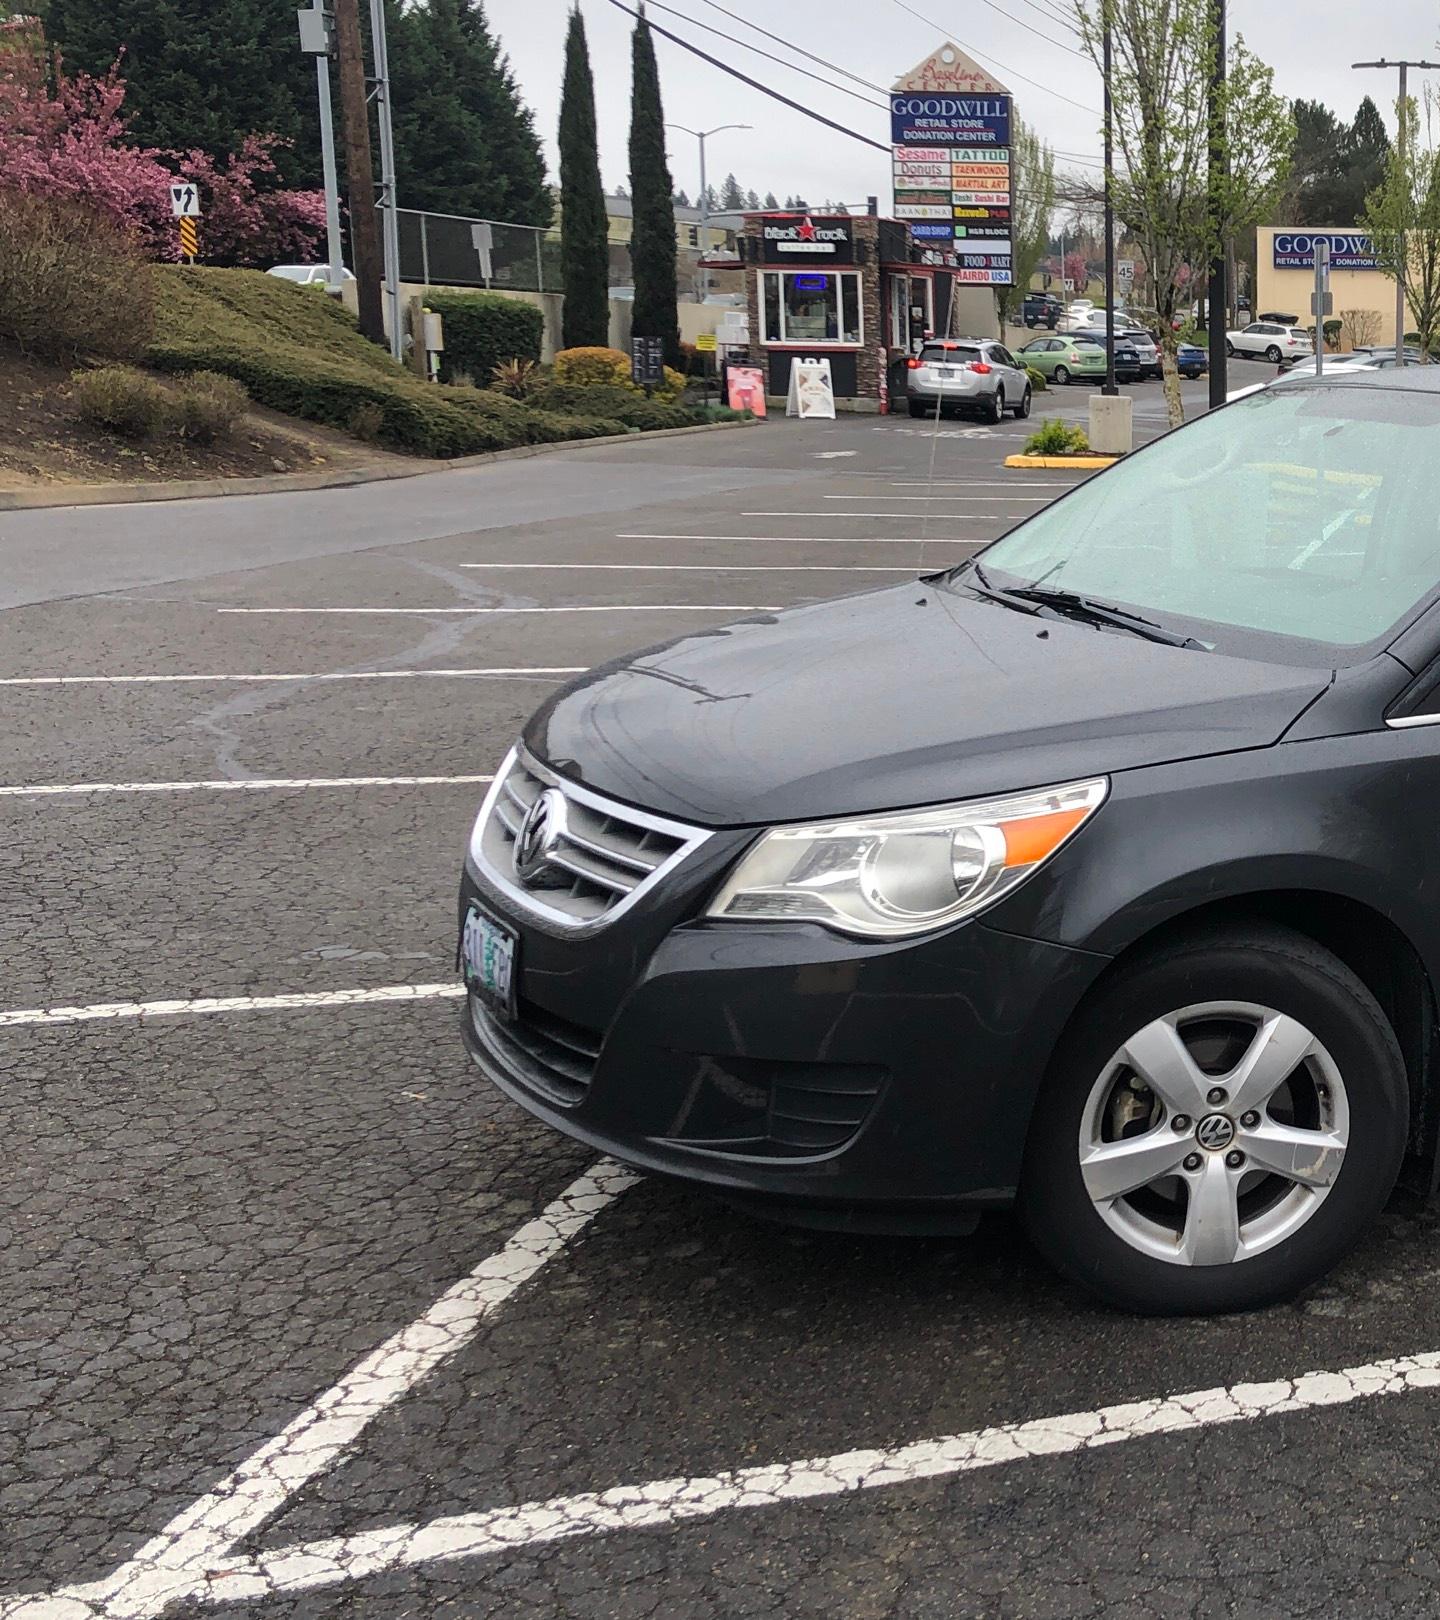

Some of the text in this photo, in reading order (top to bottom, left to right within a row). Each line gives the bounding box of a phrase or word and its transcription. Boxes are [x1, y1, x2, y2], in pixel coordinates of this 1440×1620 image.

[907, 81, 993, 92] CENTER
[891, 99, 1007, 117] GOODWILL
[914, 118, 985, 129] RETAIL STORE
[903, 130, 997, 142] DONATION CENTER
[896, 147, 947, 161] Sesame
[953, 150, 1007, 161] TATTOO
[901, 162, 943, 175] Donuts
[955, 165, 1008, 175] TAEKWONDO
[956, 179, 990, 189] MARTIAL
[991, 180, 1007, 189] ART
[974, 194, 995, 203] Sushi
[996, 194, 1009, 203] Bar
[764, 226, 848, 241] black rock
[931, 225, 951, 236] SHOP
[985, 227, 1009, 236] BLOCK
[1275, 236, 1399, 254] GODWI
[963, 255, 986, 267] FOOD
[1276, 257, 1301, 265] RETAIL
[1336, 258, 1373, 266] DONATION
[991, 271, 1010, 282] USA
[1119, 267, 1134, 279] 45
